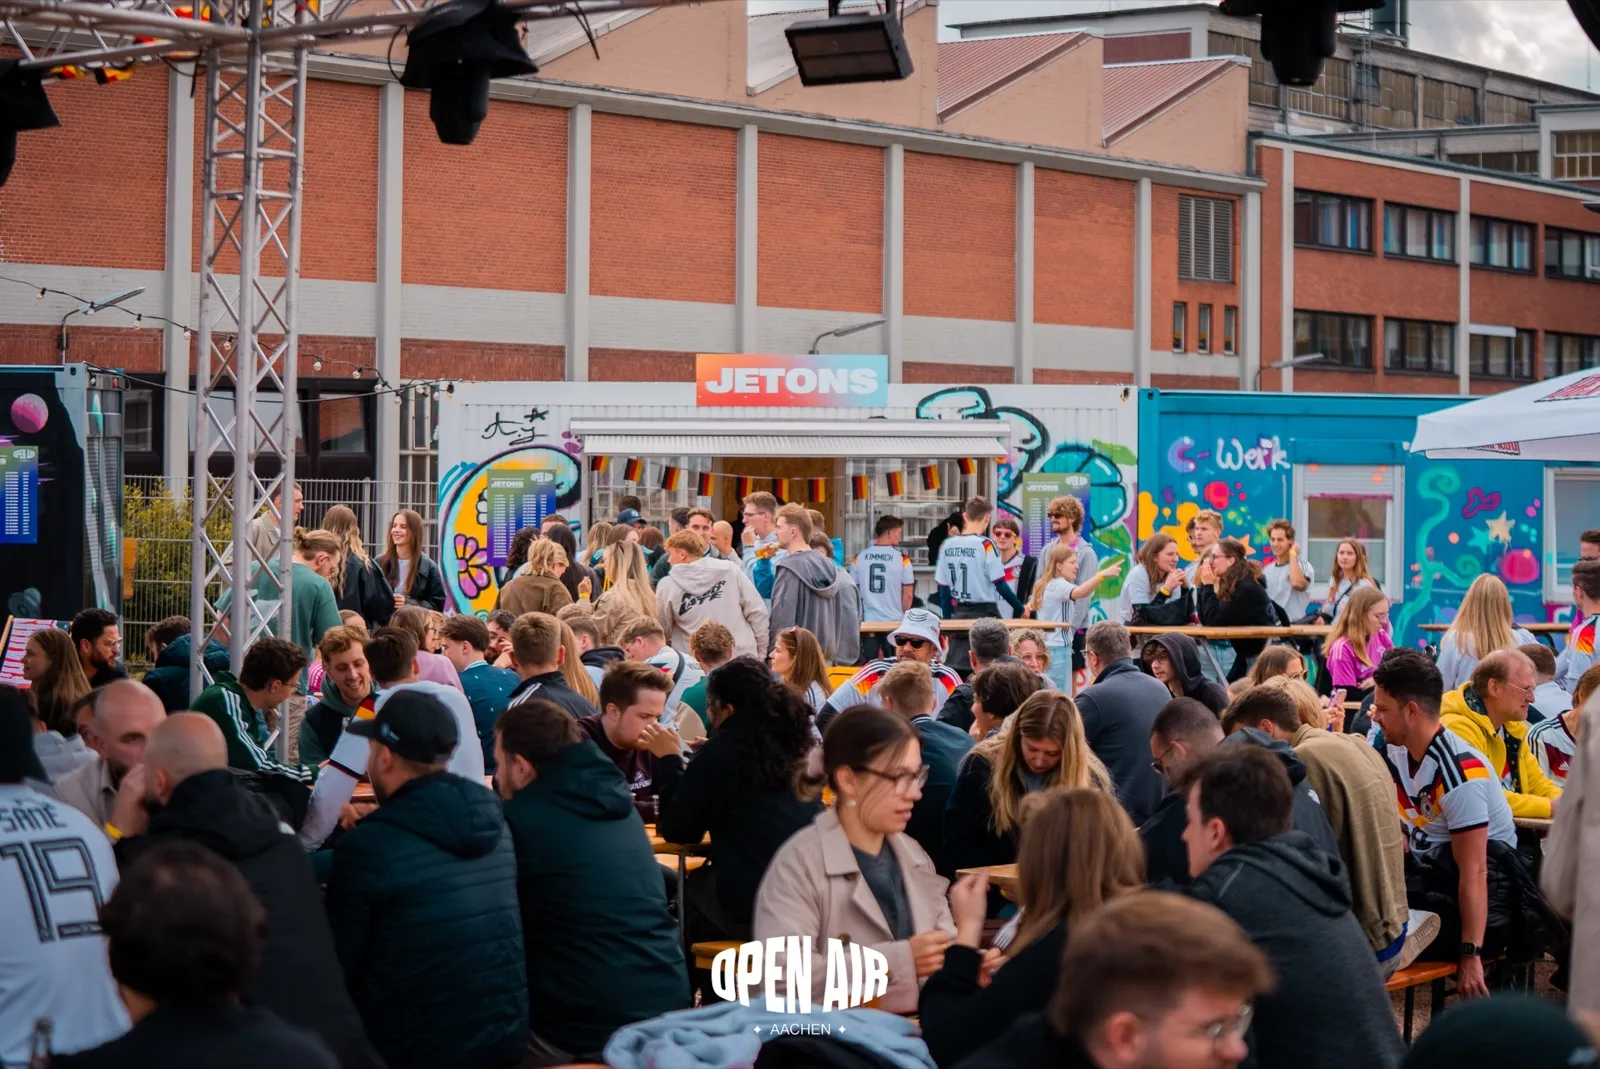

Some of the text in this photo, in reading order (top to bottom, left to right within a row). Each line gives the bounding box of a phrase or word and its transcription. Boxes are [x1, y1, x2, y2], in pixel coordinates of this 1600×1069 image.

[705, 368, 879, 394] JETONS
[1027, 484, 1059, 492] JETONS
[864, 553, 894, 562] KIMMICH
[869, 563, 886, 594] 6
[948, 562, 972, 600] 11
[0, 837, 105, 944] 19
